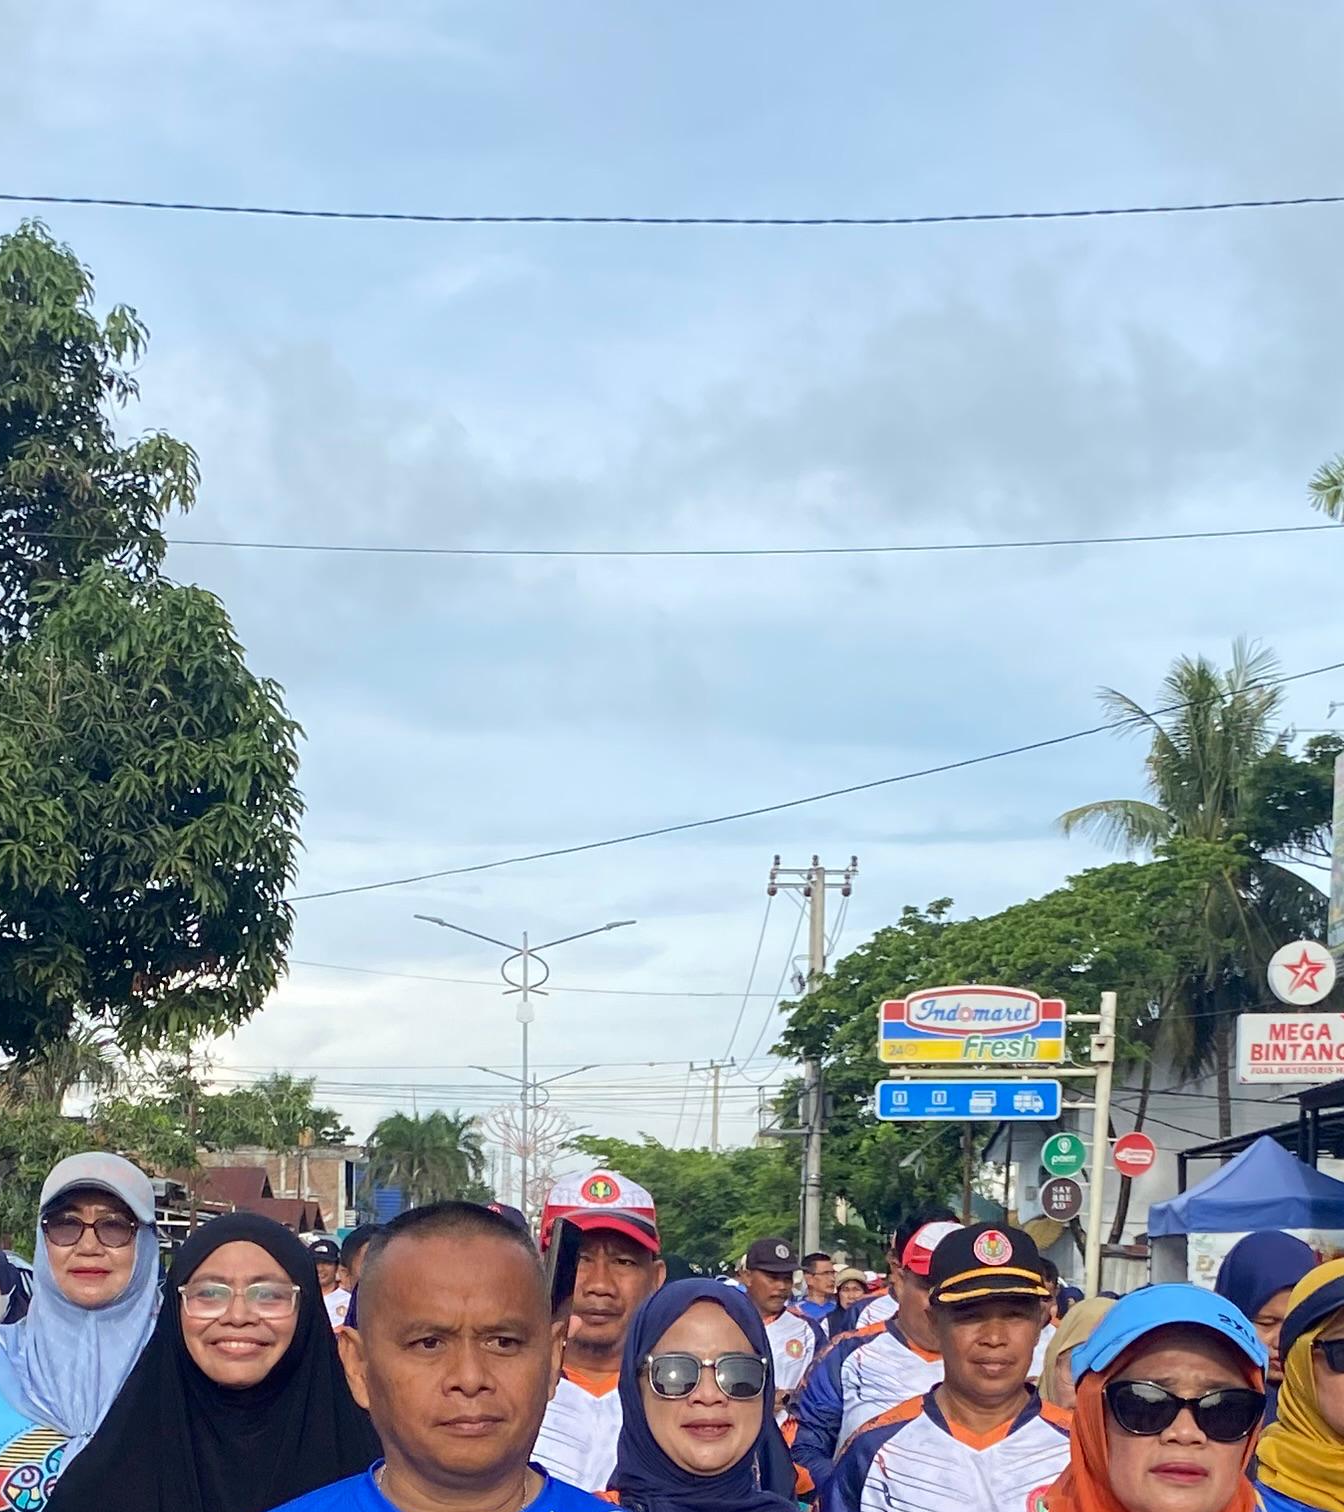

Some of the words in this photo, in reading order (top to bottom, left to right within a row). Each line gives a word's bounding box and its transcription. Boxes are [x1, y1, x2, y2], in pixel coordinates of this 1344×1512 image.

[915, 1000, 1032, 1022] Indomaret
[1269, 1023, 1332, 1041] MEGA
[962, 1034, 1038, 1059] Fresh
[1052, 1186, 1071, 1194] SAY
